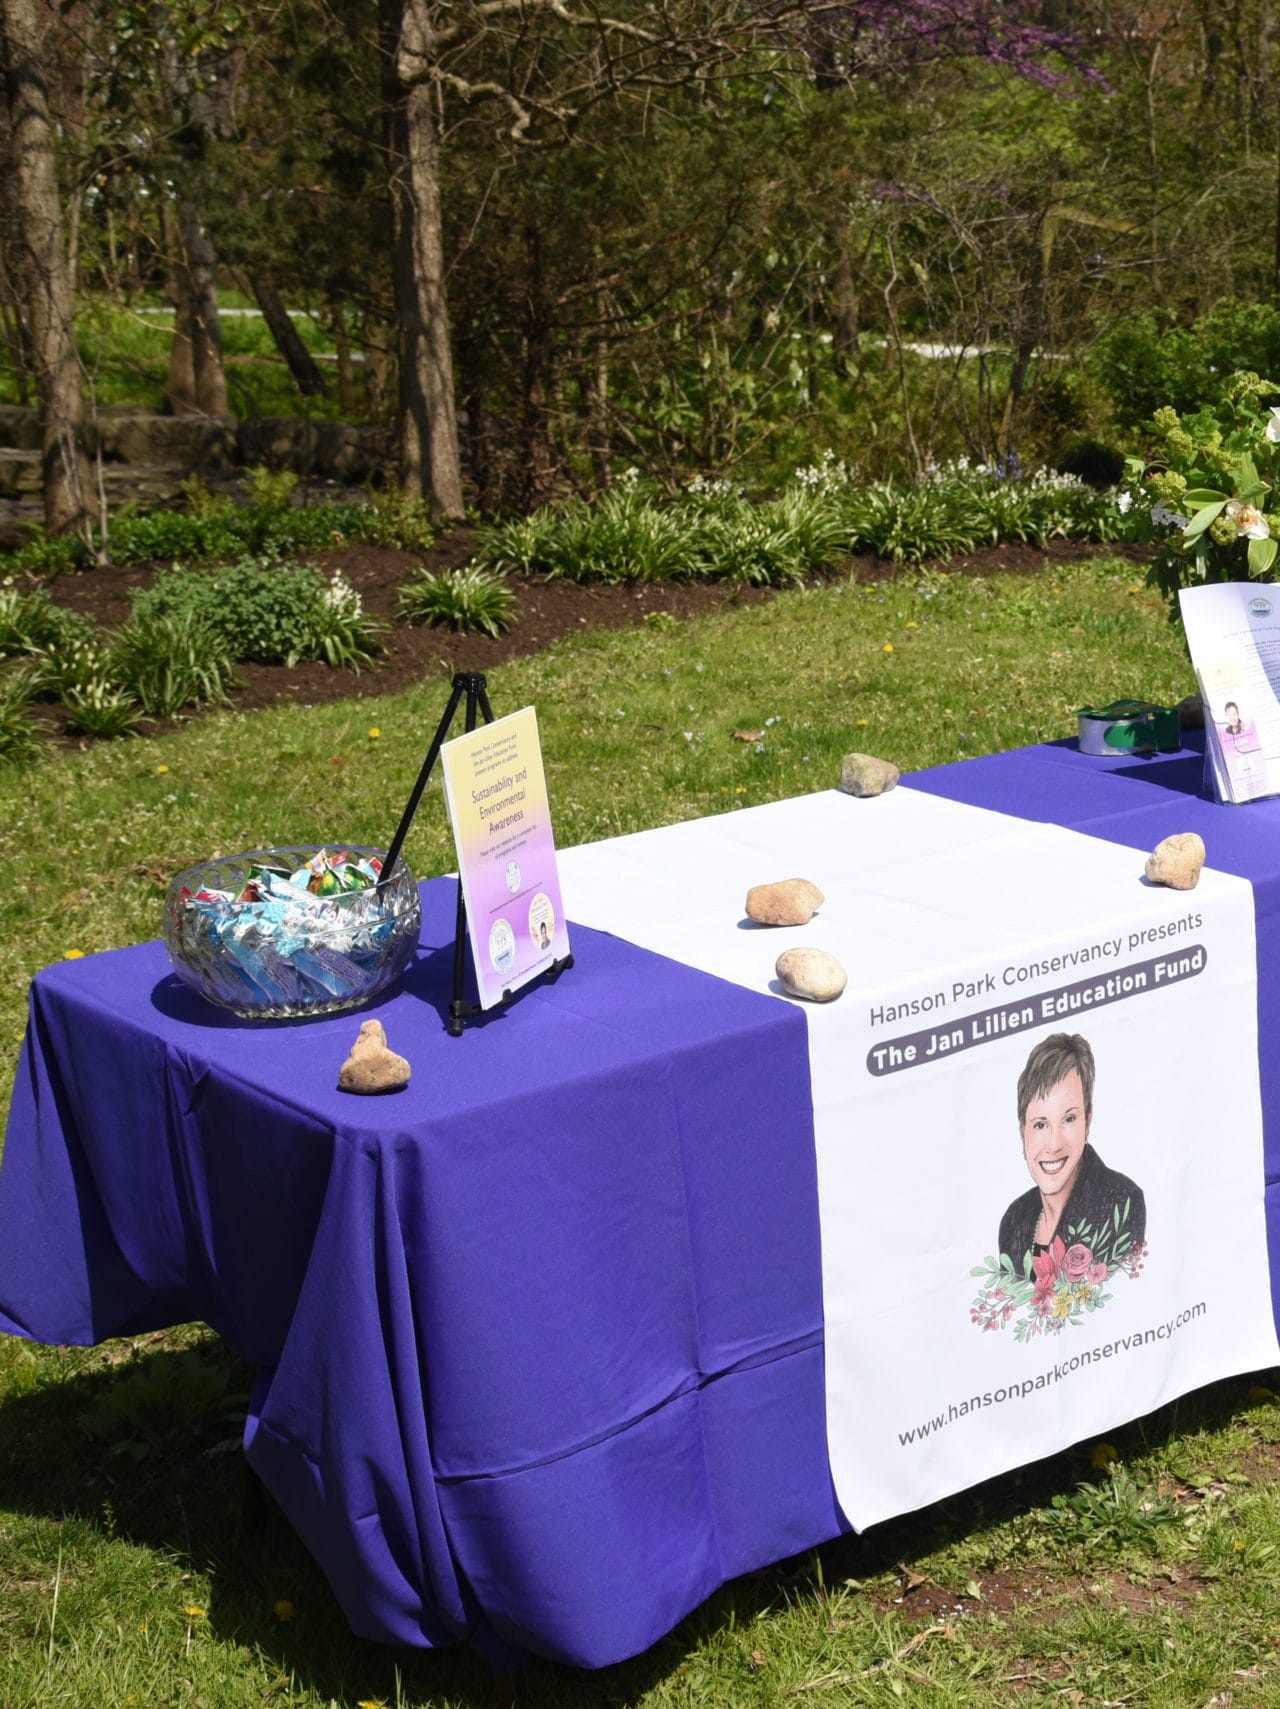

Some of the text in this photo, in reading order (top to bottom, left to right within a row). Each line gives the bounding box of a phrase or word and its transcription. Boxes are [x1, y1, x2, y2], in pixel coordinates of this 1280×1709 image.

[471, 765, 527, 804] Sustainability and
[479, 785, 526, 820] Environmental
[489, 810, 524, 836] Awareness
[870, 913, 1203, 1027] Hanson Park Conservancy presents
[873, 949, 1203, 1070] The Jan Lilien Education Fund
[898, 1301, 1207, 1447] www.hansonparkconservancy.com
